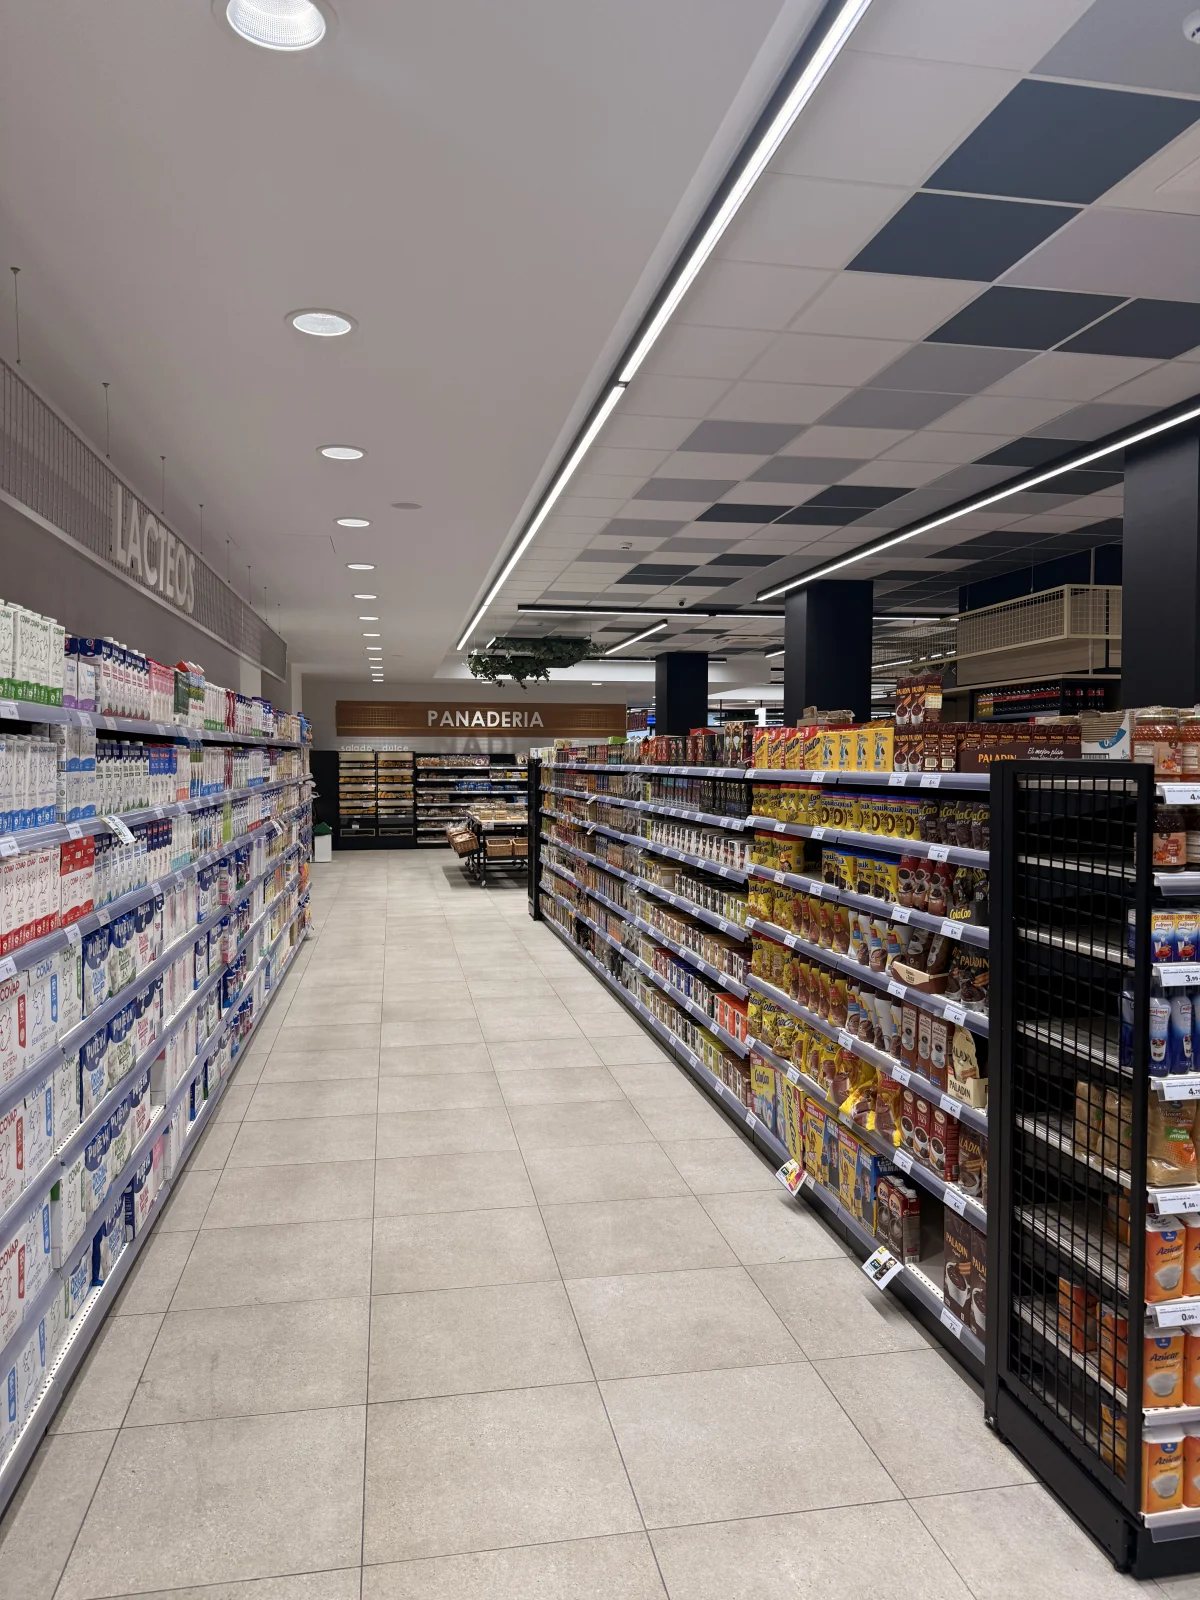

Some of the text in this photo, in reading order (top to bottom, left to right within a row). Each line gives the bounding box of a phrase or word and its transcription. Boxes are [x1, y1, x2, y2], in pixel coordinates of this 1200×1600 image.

[113, 483, 195, 613] LACTEOS
[427, 710, 544, 728] PANADERIA
[340, 744, 372, 752] salado
[382, 744, 409, 752] dulce
[978, 753, 1017, 763] PALADIN
[949, 908, 972, 920] ColaCao
[0, 980, 20, 1002] COVAP
[949, 1079, 972, 1100] PALADIN
[946, 1231, 968, 1258] PALADIN
[1156, 1243, 1183, 1256] Azúcar
[0, 1238, 19, 1270] COVAP
[972, 1255, 987, 1278] PALA
[1149, 1351, 1180, 1362] Azúcar
[1153, 1455, 1182, 1466] Azúcar
